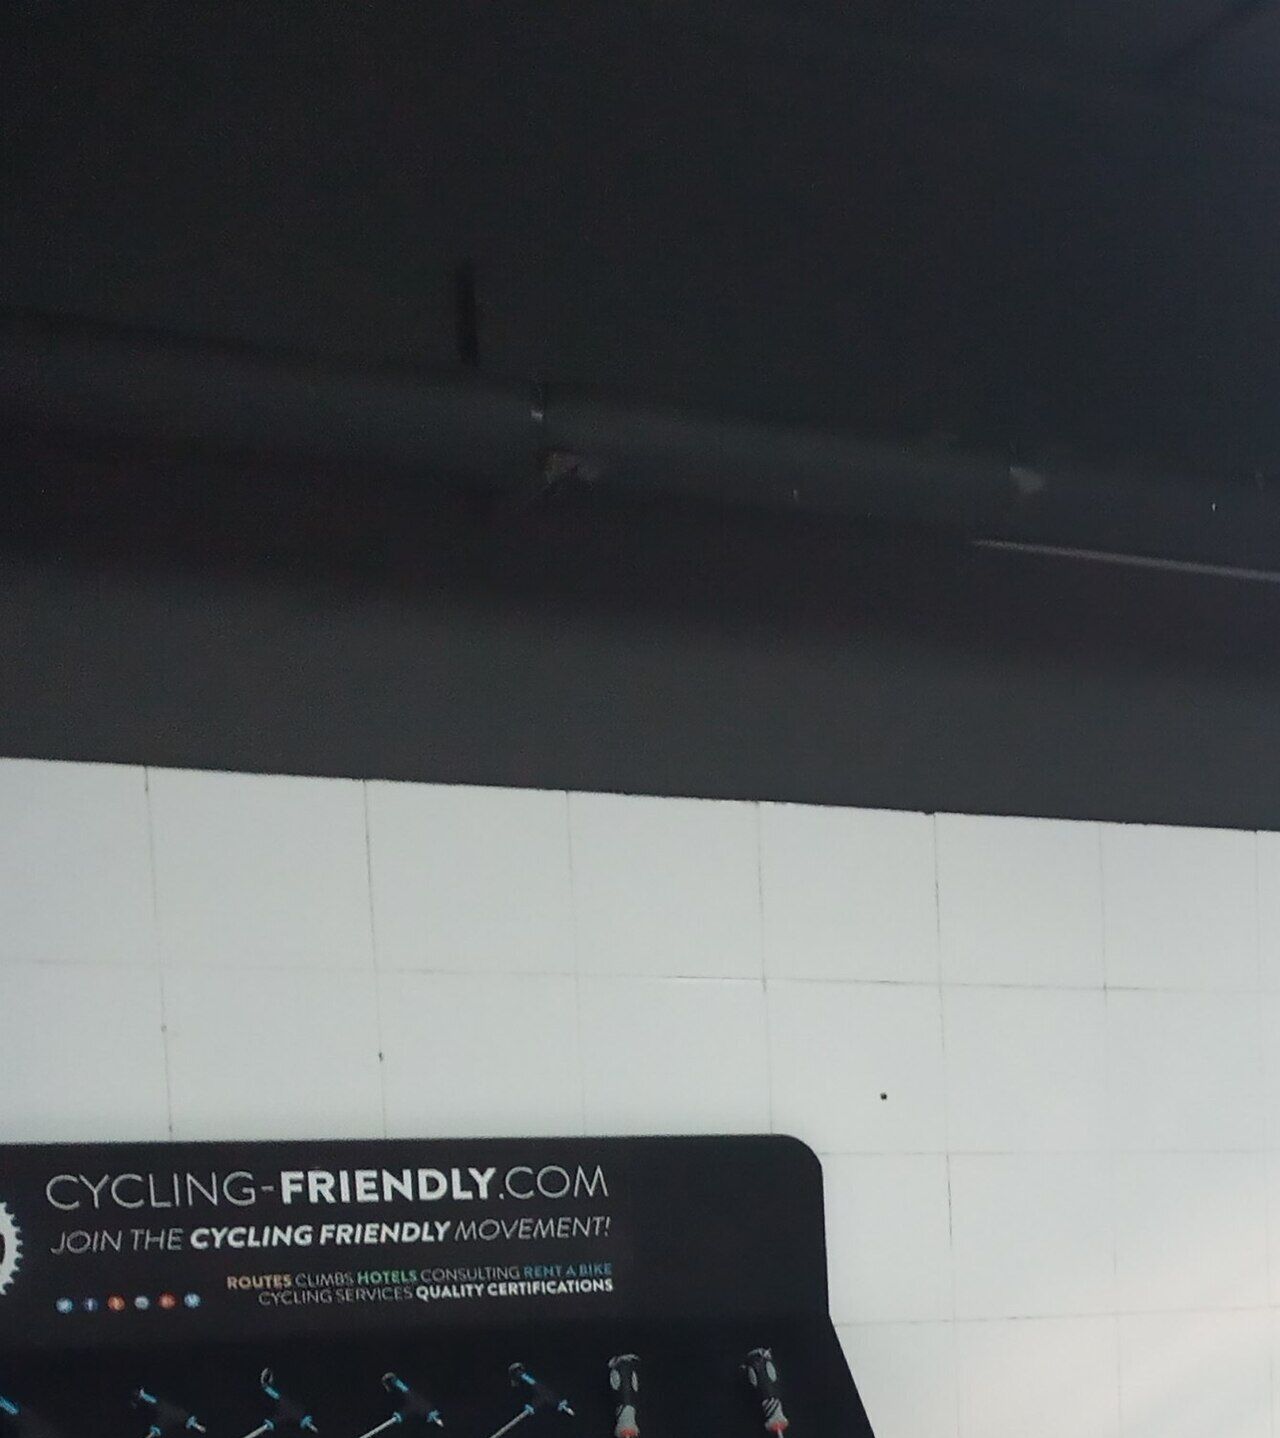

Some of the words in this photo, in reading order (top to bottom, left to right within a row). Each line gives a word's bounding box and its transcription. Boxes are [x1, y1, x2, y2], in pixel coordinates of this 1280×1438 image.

[45, 1165, 610, 1211] CYCLING-FRIENDLY.COM
[50, 1229, 123, 1254] JOIN
[130, 1227, 184, 1251] THE
[190, 1224, 313, 1249] CYCLING
[319, 1219, 451, 1246] FRIENDLY
[454, 1216, 611, 1242] MOVEMENT!
[226, 1274, 292, 1290] ROUTES
[357, 1269, 417, 1285] HOTELS
[420, 1266, 520, 1283] CONSULTING
[523, 1265, 562, 1279] RENT
[565, 1263, 578, 1277] A
[579, 1262, 612, 1277] BIKE
[258, 1291, 332, 1307] CYCLING
[334, 1286, 413, 1303] SERVICES
[416, 1283, 484, 1302] QUALITY
[487, 1278, 614, 1297] CERTIFICATIONS
